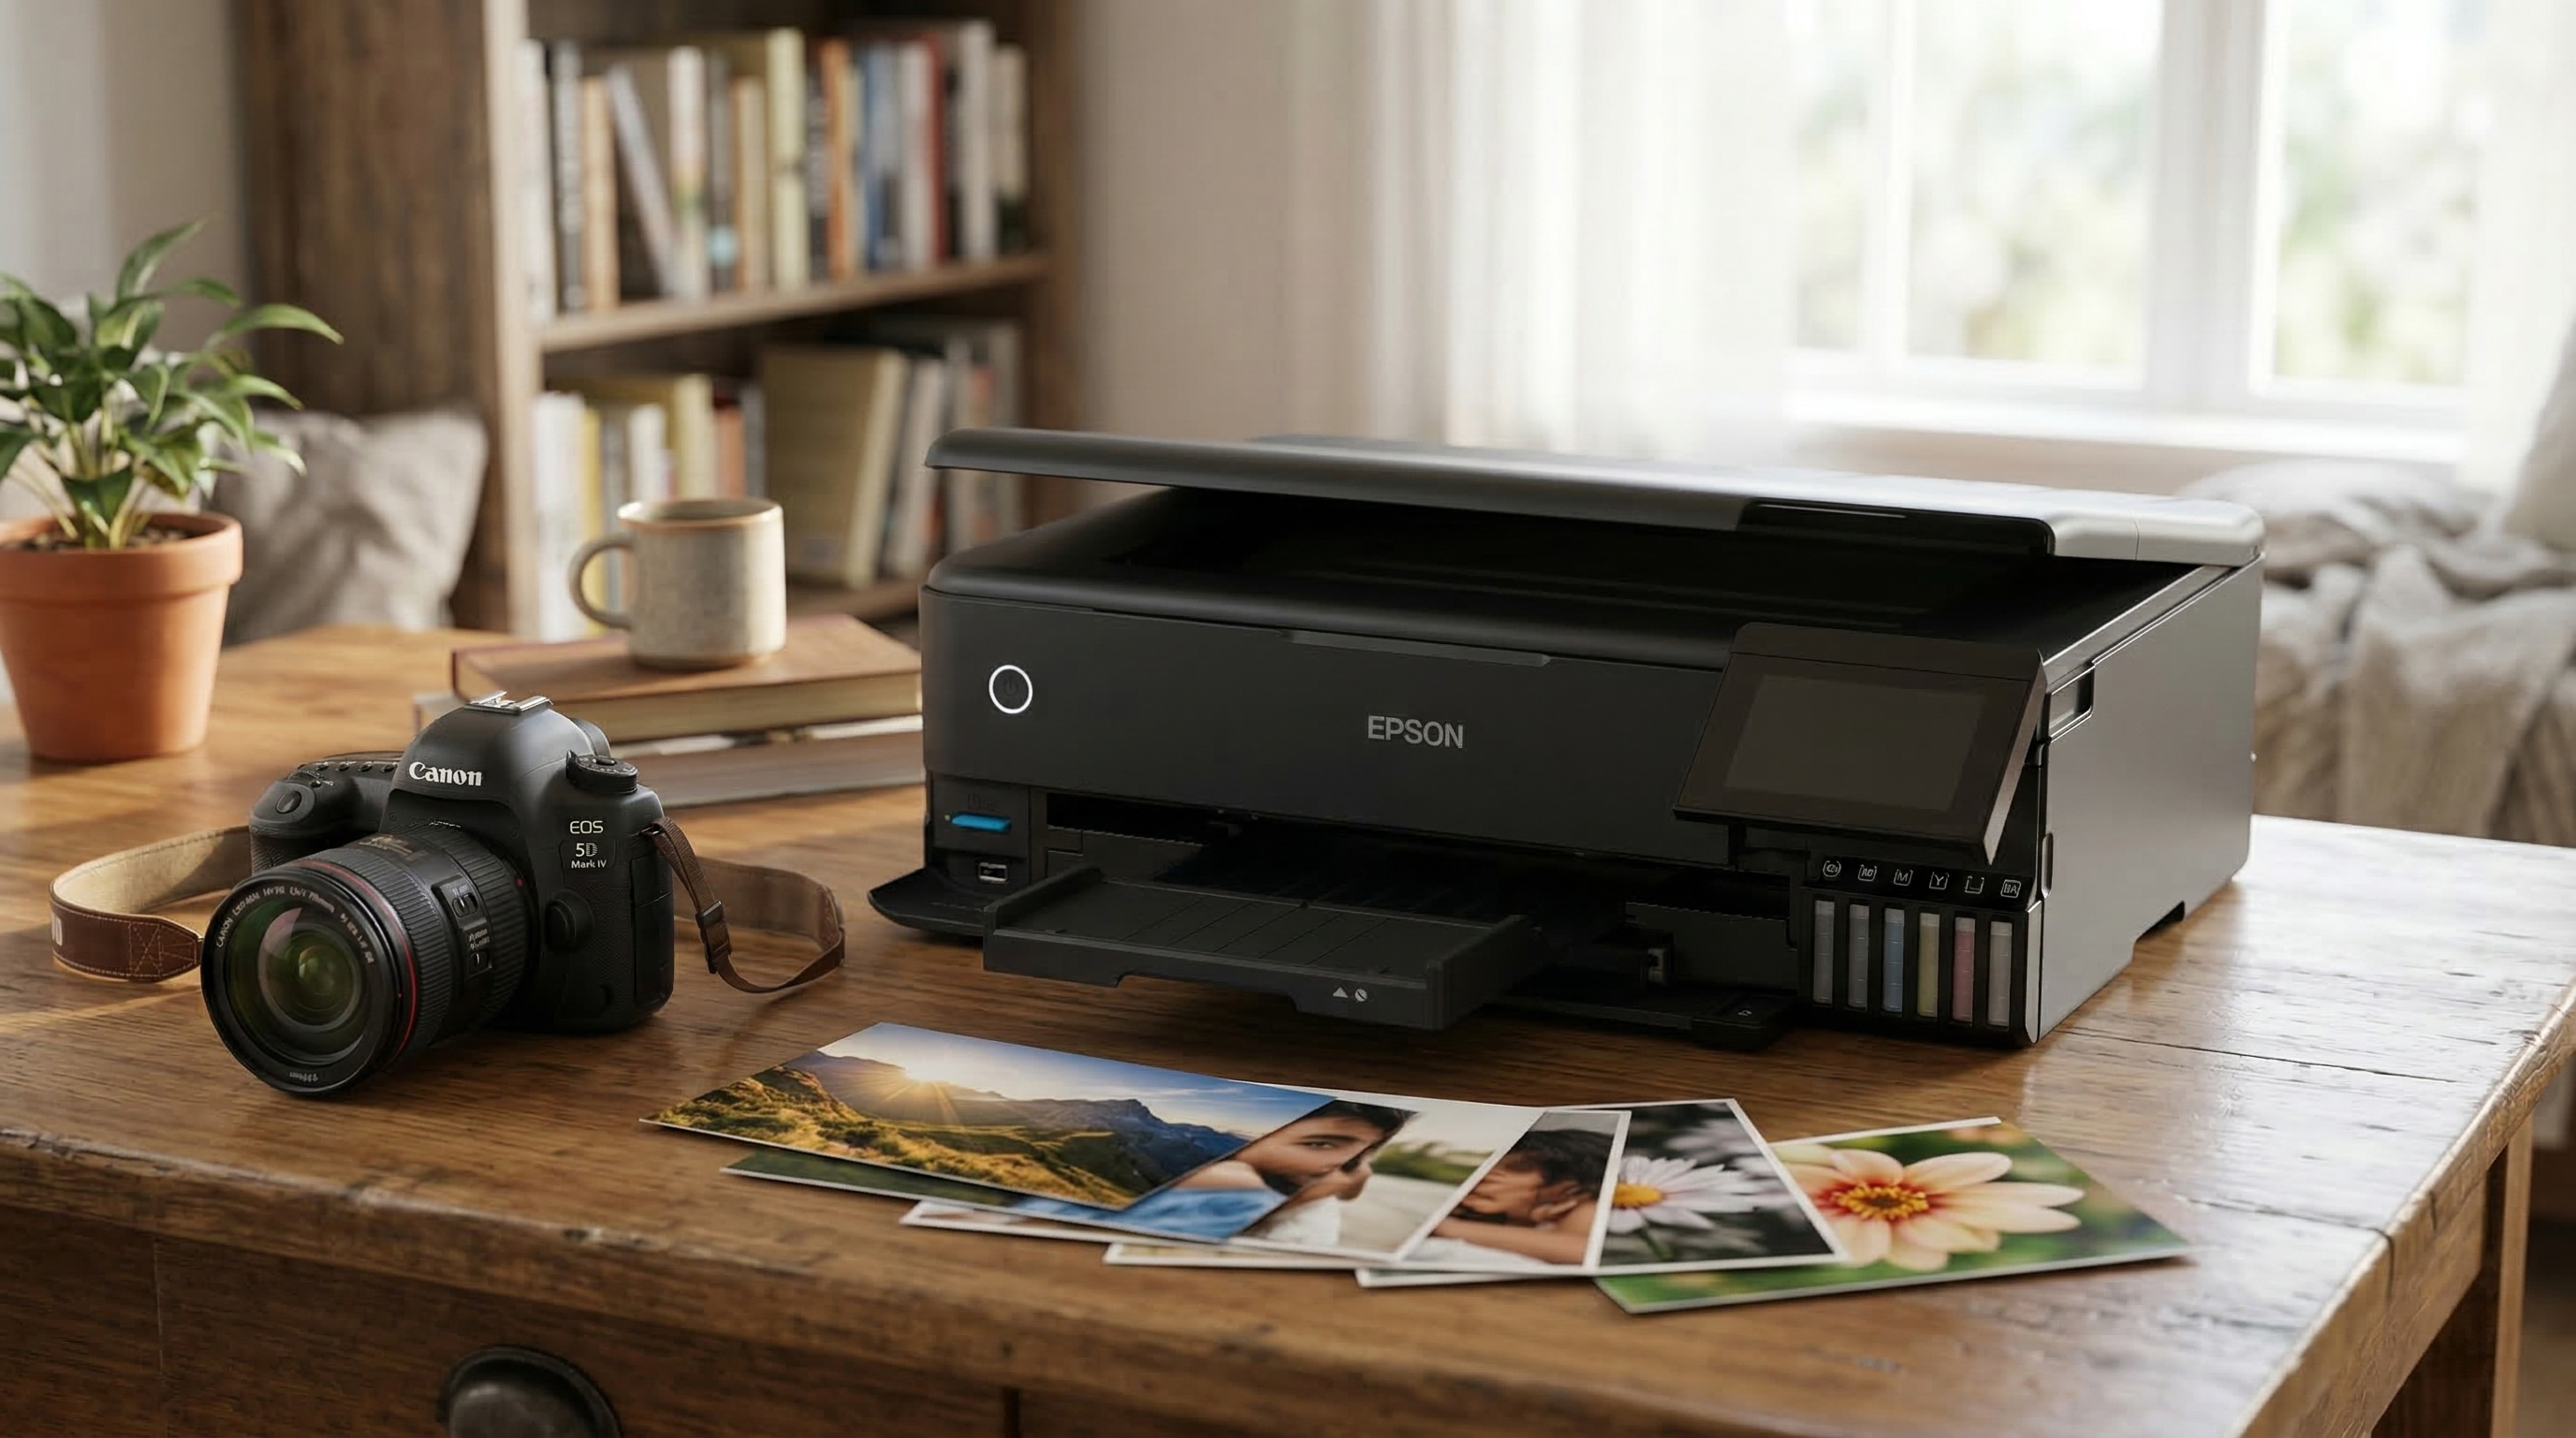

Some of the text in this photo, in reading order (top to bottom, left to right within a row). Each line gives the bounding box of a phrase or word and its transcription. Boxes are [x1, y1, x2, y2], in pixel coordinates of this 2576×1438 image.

[1368, 715, 1464, 749] EPSON
[409, 761, 482, 786] Canon
[569, 820, 604, 834] EOS
[575, 843, 598, 858] 5D
[571, 858, 607, 869] Mark IV
[216, 917, 233, 947] CANON
